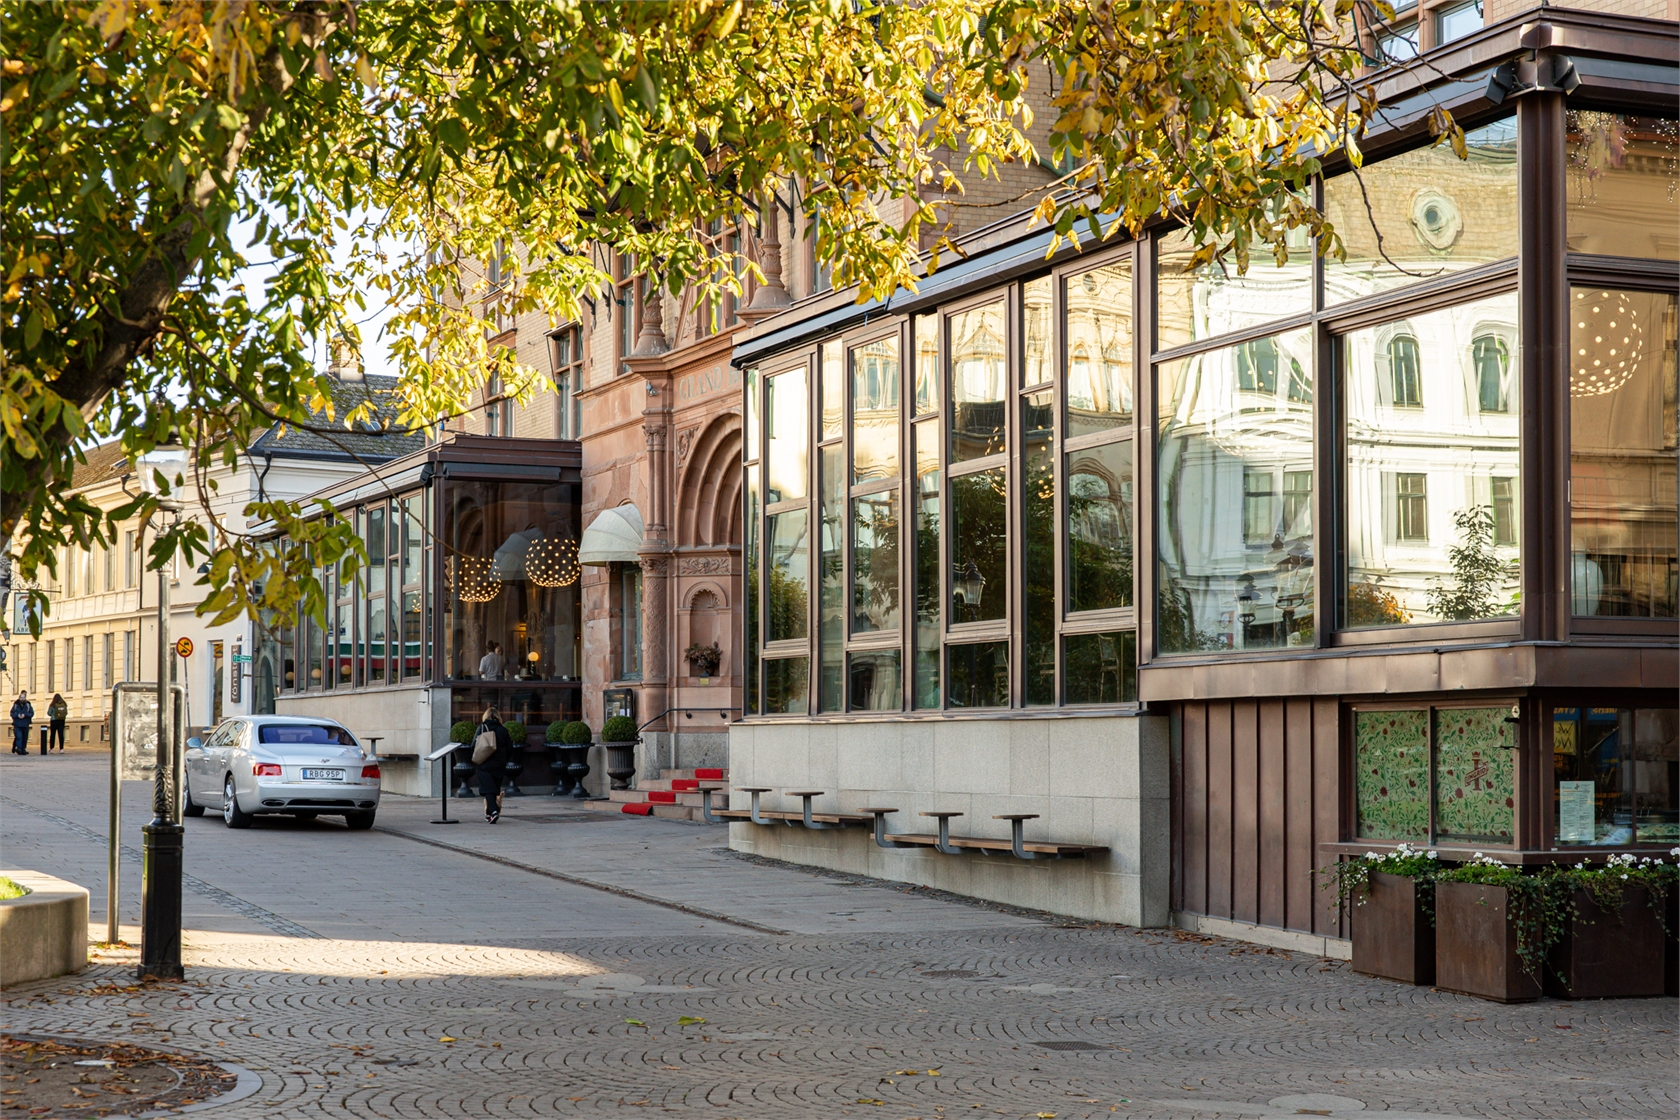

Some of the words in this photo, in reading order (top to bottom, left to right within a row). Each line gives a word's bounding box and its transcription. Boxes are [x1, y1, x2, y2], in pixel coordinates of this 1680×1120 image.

[679, 366, 723, 401] GRAND
[310, 770, 324, 778] RBG
[325, 770, 340, 778] 95P
